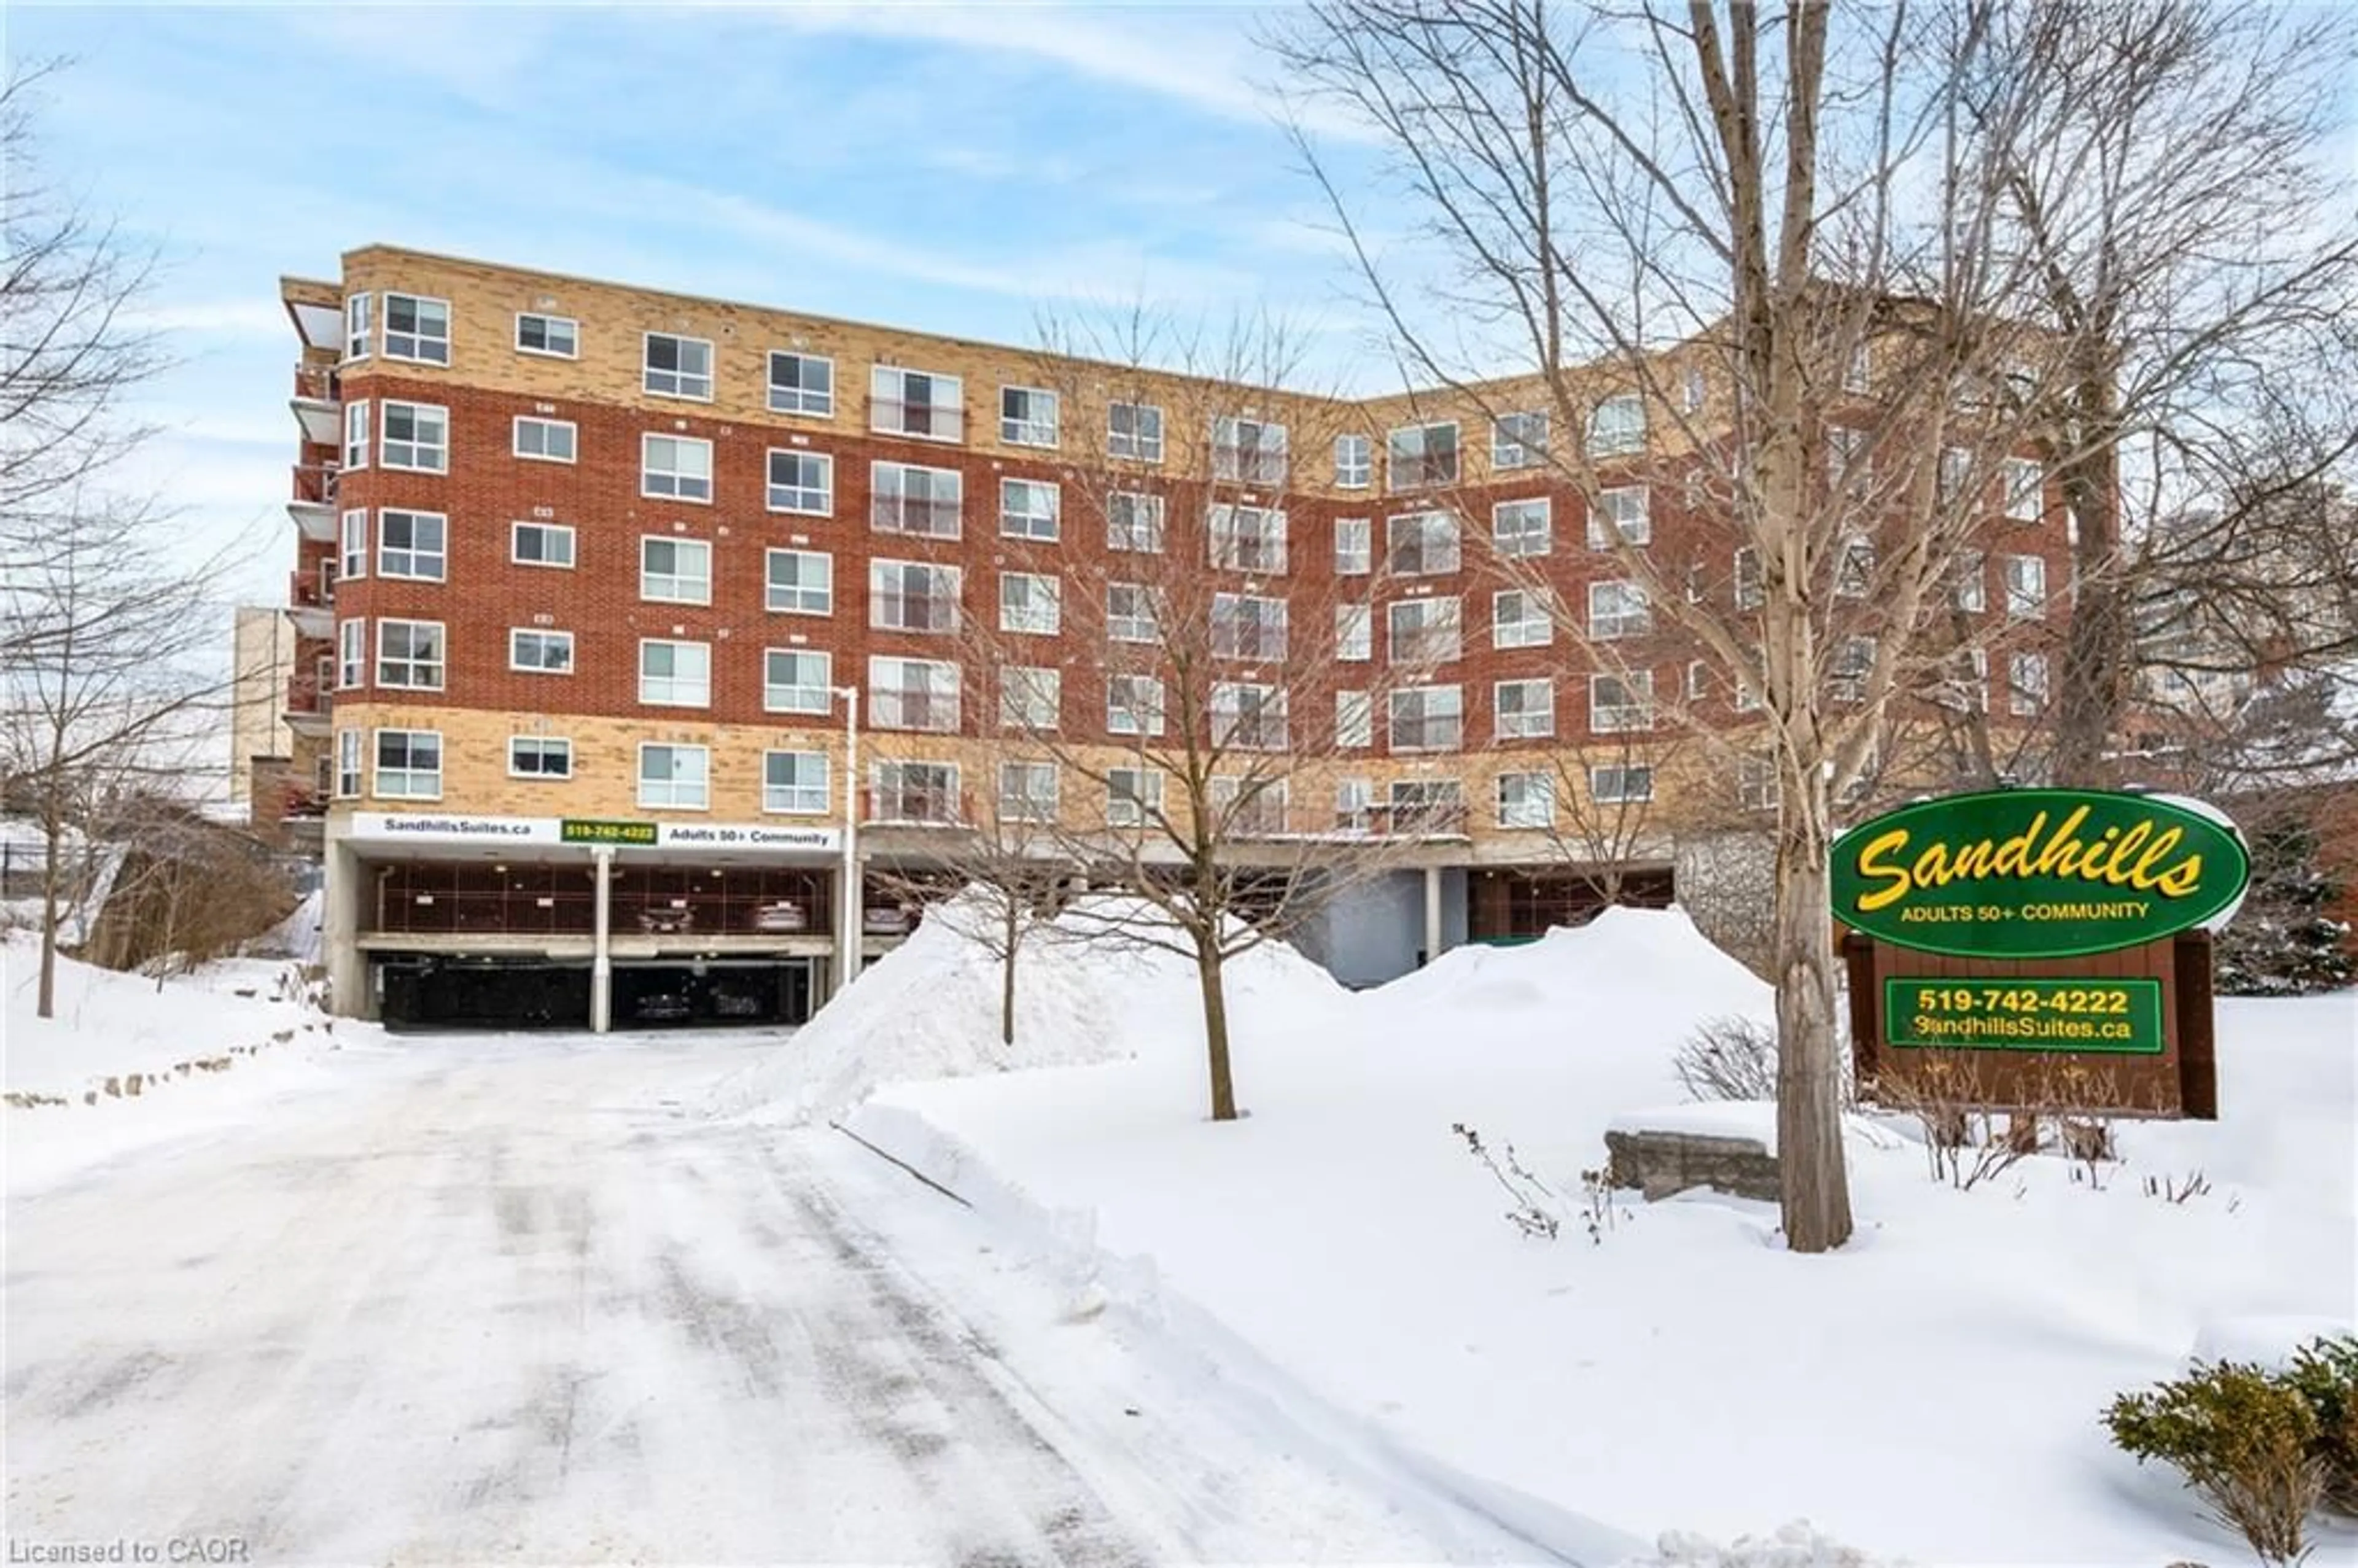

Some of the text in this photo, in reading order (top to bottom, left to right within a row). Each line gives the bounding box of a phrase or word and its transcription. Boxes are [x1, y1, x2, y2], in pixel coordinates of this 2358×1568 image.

[384, 818, 532, 835] SandhillsSuites.ca
[669, 829, 829, 847] Adults 50+ Community
[1855, 805, 2203, 913] Sandhills
[1901, 902, 2149, 922] ADULTS 50+ COMMUNITY
[1918, 988, 2129, 1014] 519-742-4222
[1913, 1014, 2132, 1039] SandhillsSuites.ca
